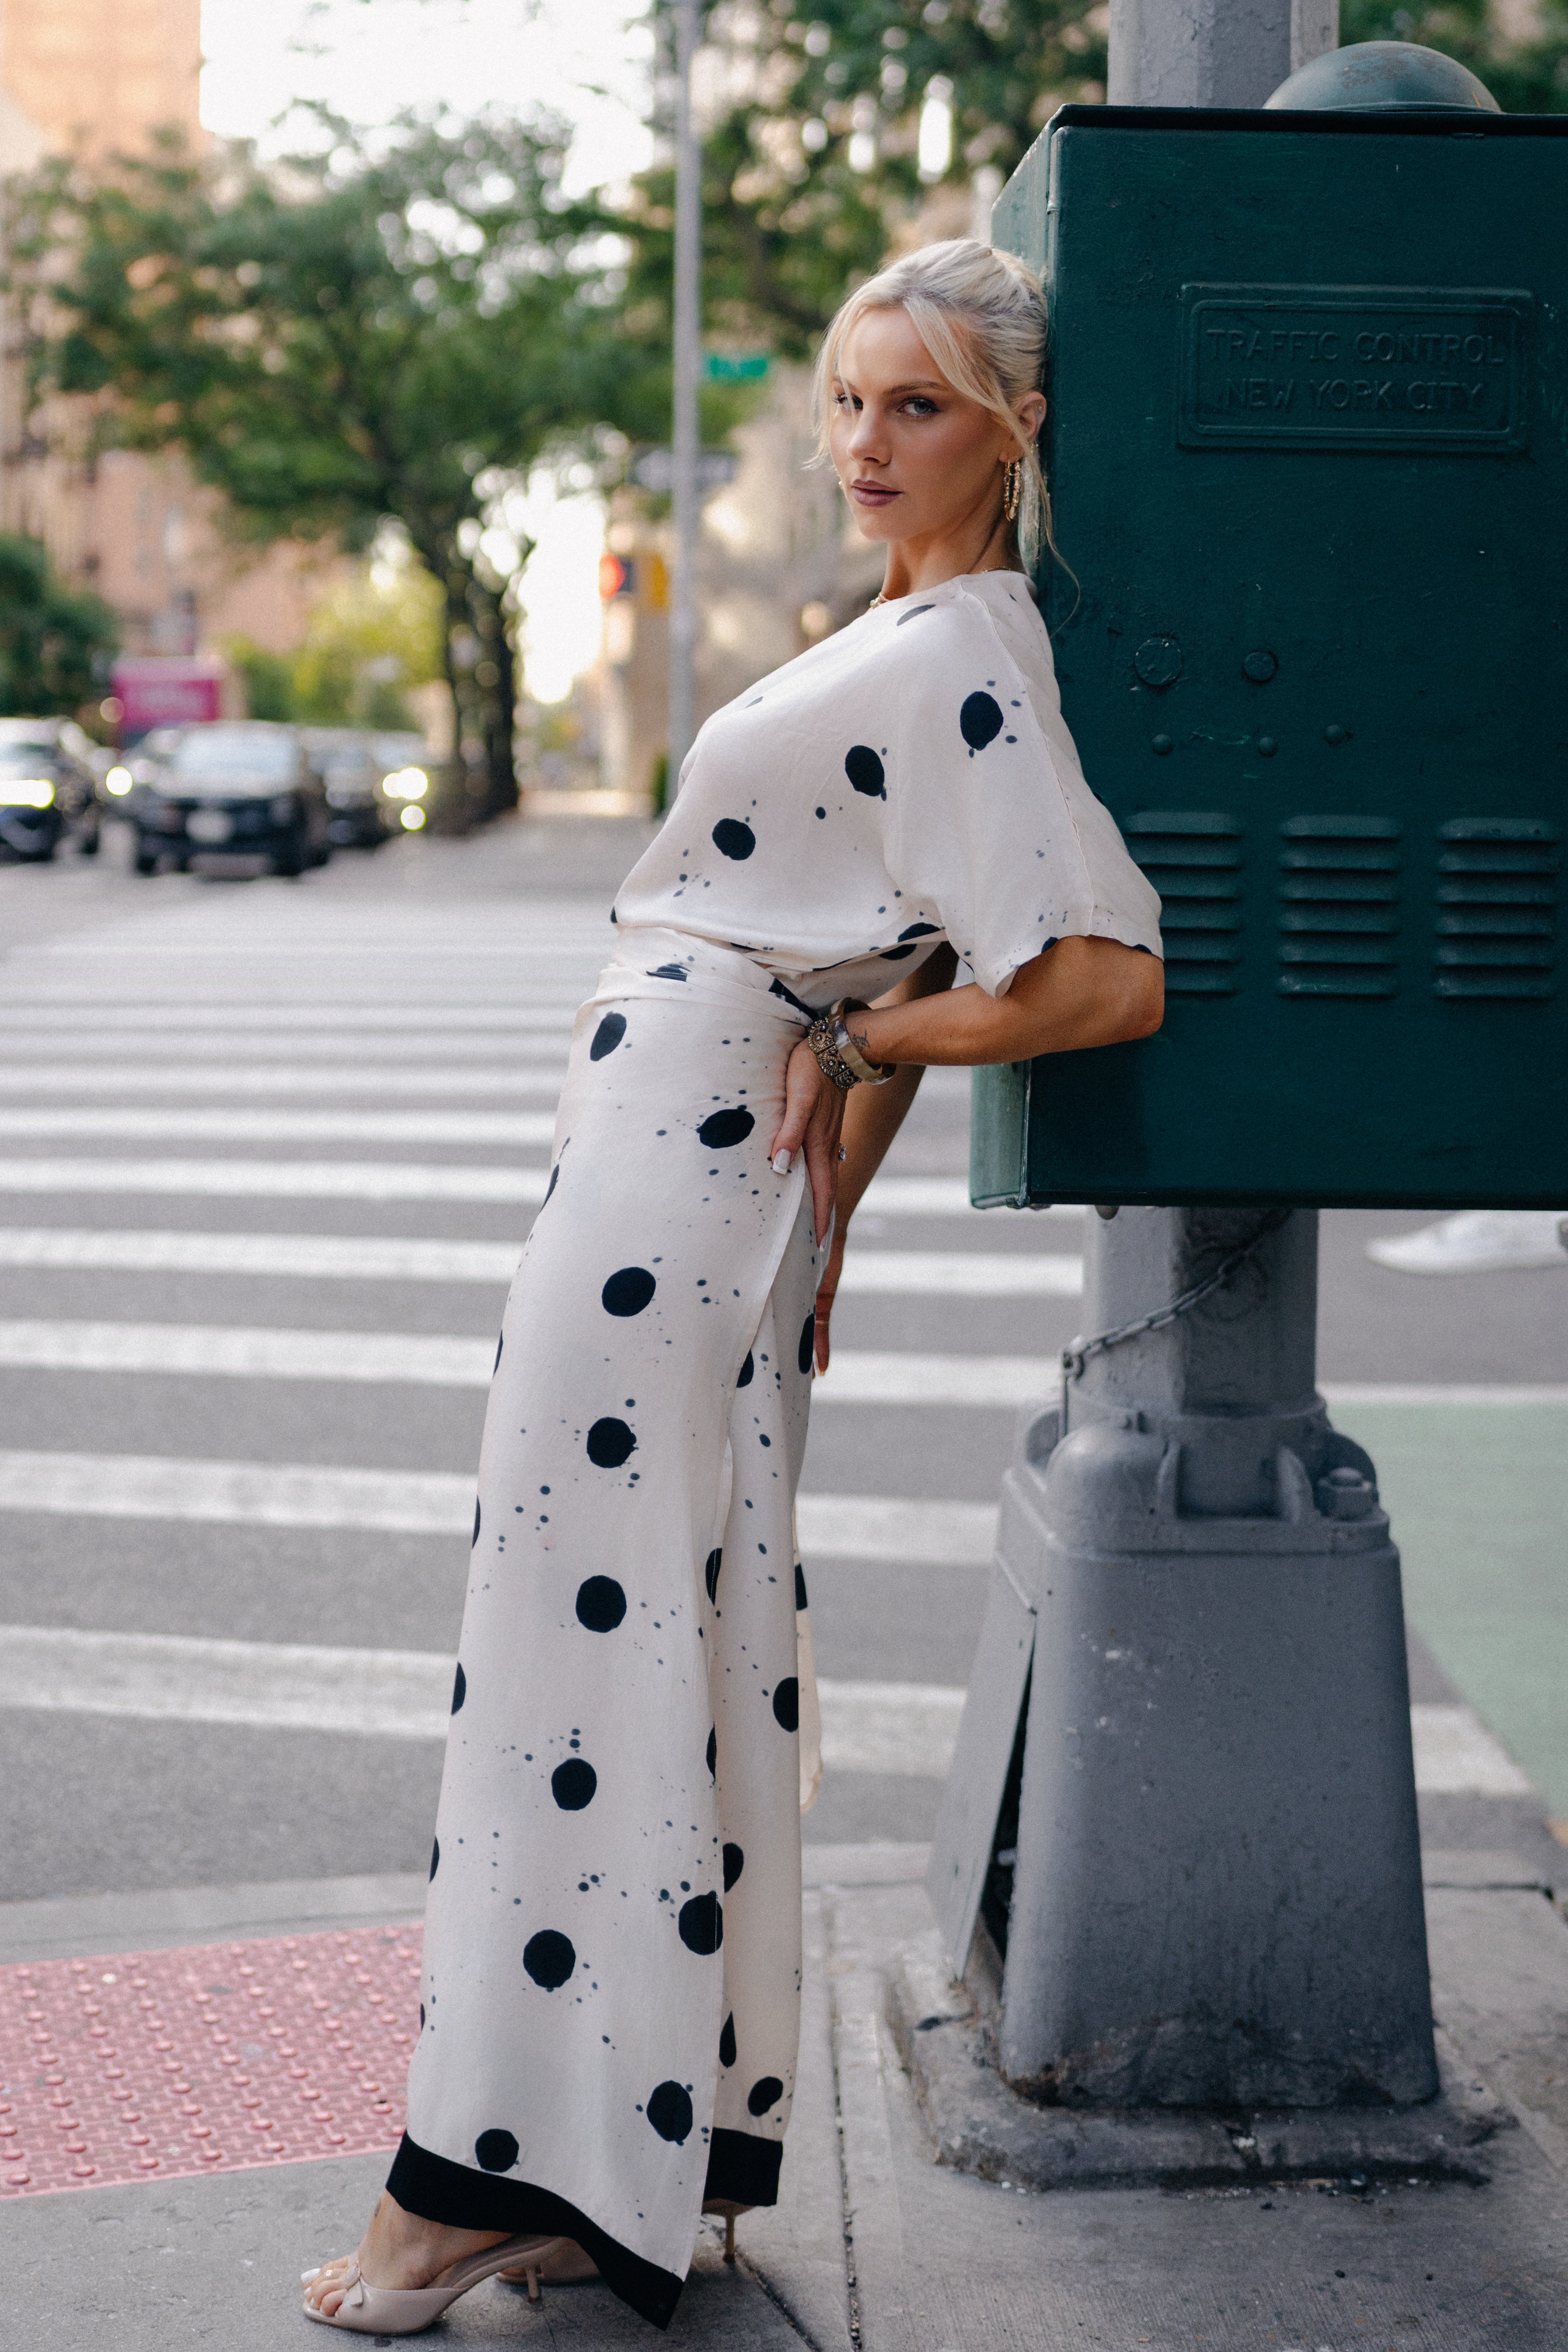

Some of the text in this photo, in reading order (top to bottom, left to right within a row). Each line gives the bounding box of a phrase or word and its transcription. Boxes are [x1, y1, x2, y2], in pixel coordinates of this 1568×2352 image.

[1206, 329, 1505, 365] TRAFFIC CONTROL
[1225, 378, 1483, 411] NEW YORK CITY
